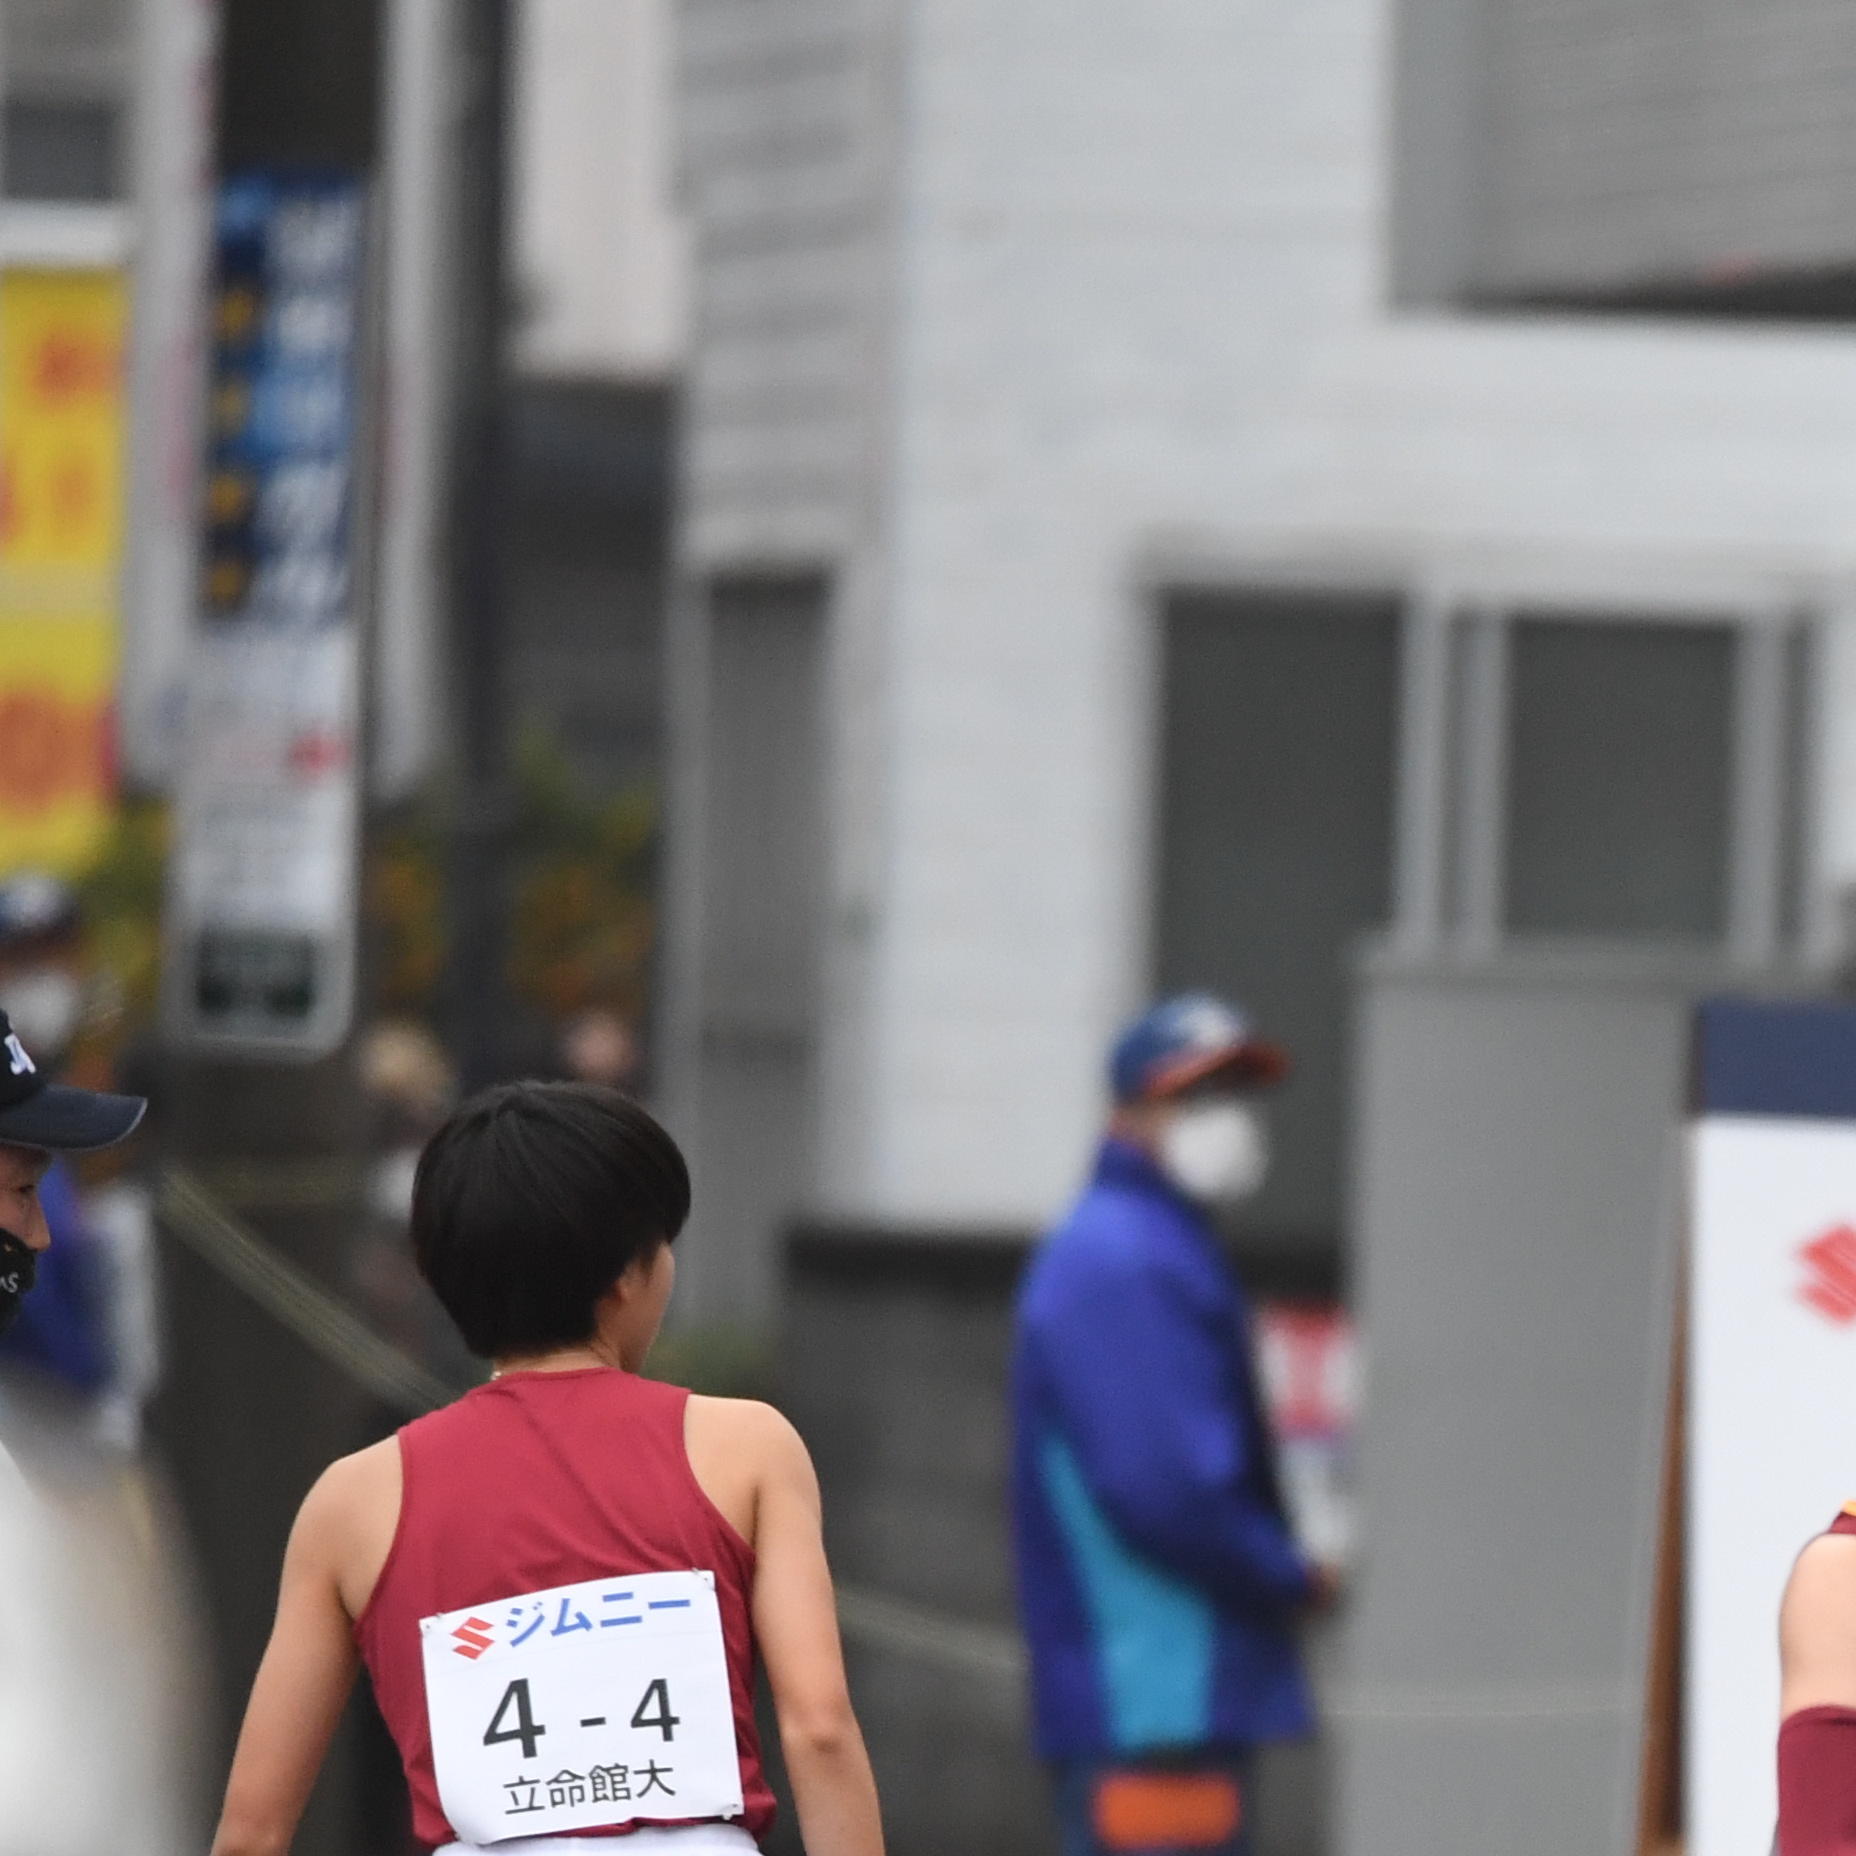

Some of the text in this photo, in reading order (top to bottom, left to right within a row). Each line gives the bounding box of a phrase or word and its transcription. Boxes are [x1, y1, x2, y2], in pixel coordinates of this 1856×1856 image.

[505, 1591, 691, 1648] ジムニー
[502, 1759, 677, 1815] 立命館大
